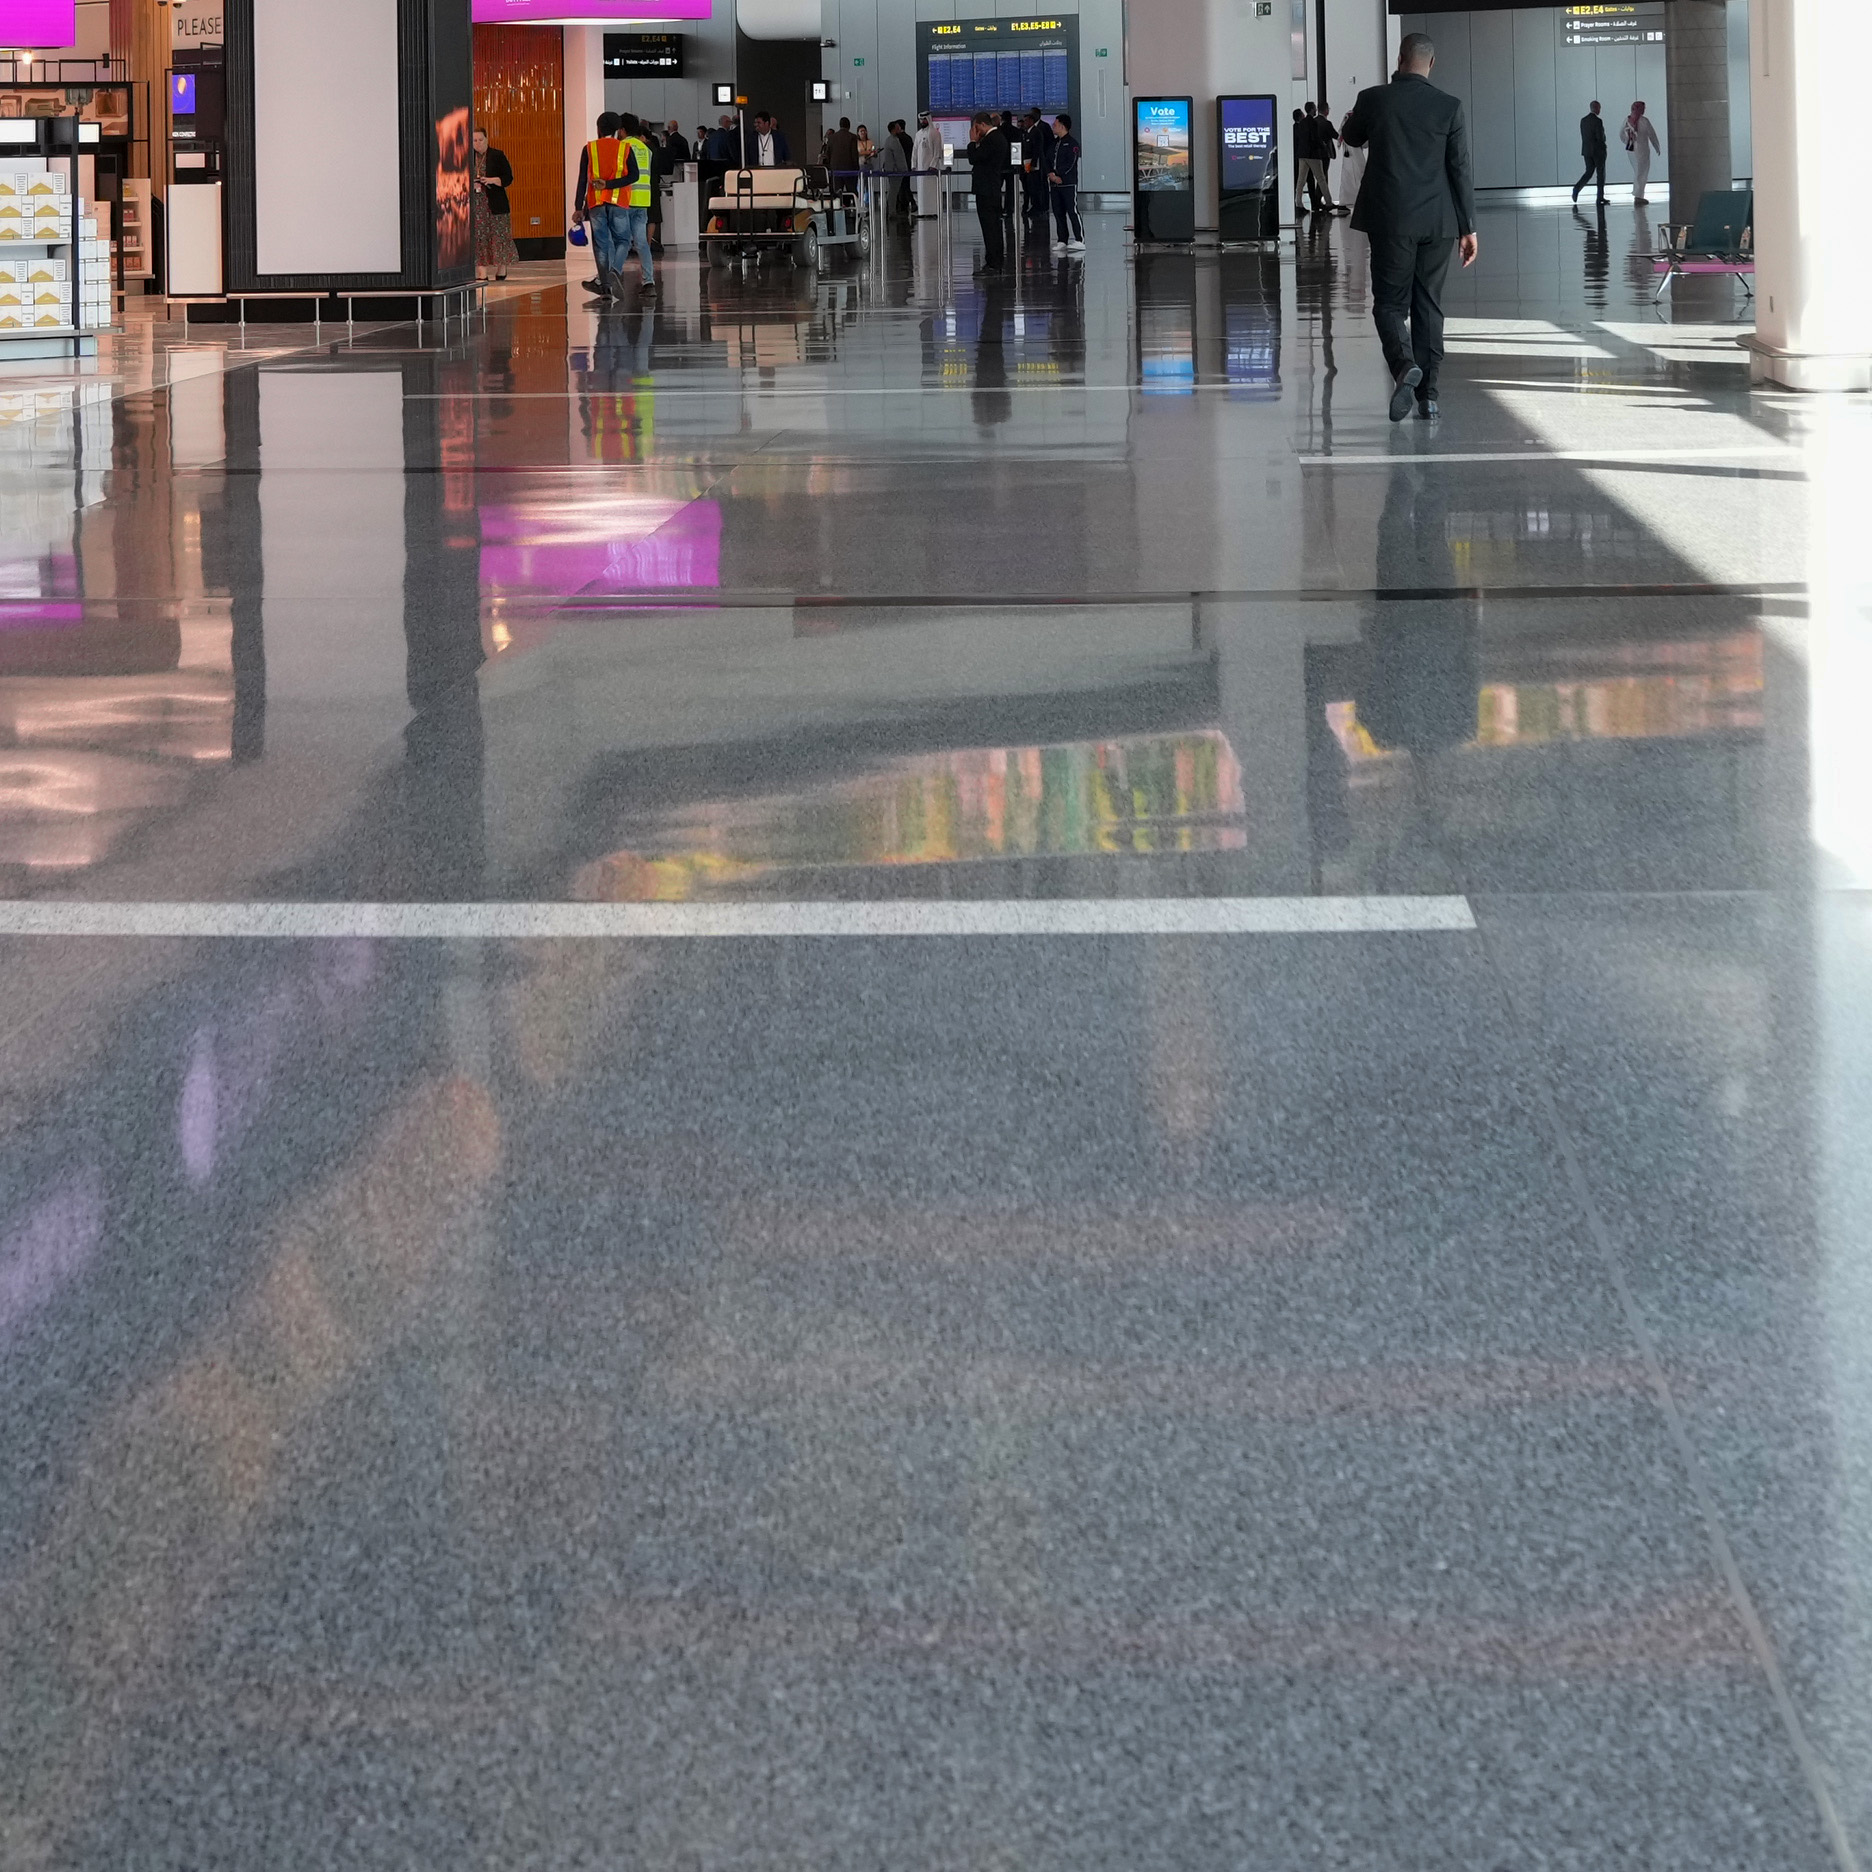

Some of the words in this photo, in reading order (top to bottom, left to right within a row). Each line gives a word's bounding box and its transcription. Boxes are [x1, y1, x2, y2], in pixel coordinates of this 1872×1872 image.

[178, 17, 222, 36] PLEASE
[1150, 107, 1175, 116] Vote
[1224, 132, 1271, 143] BEST
